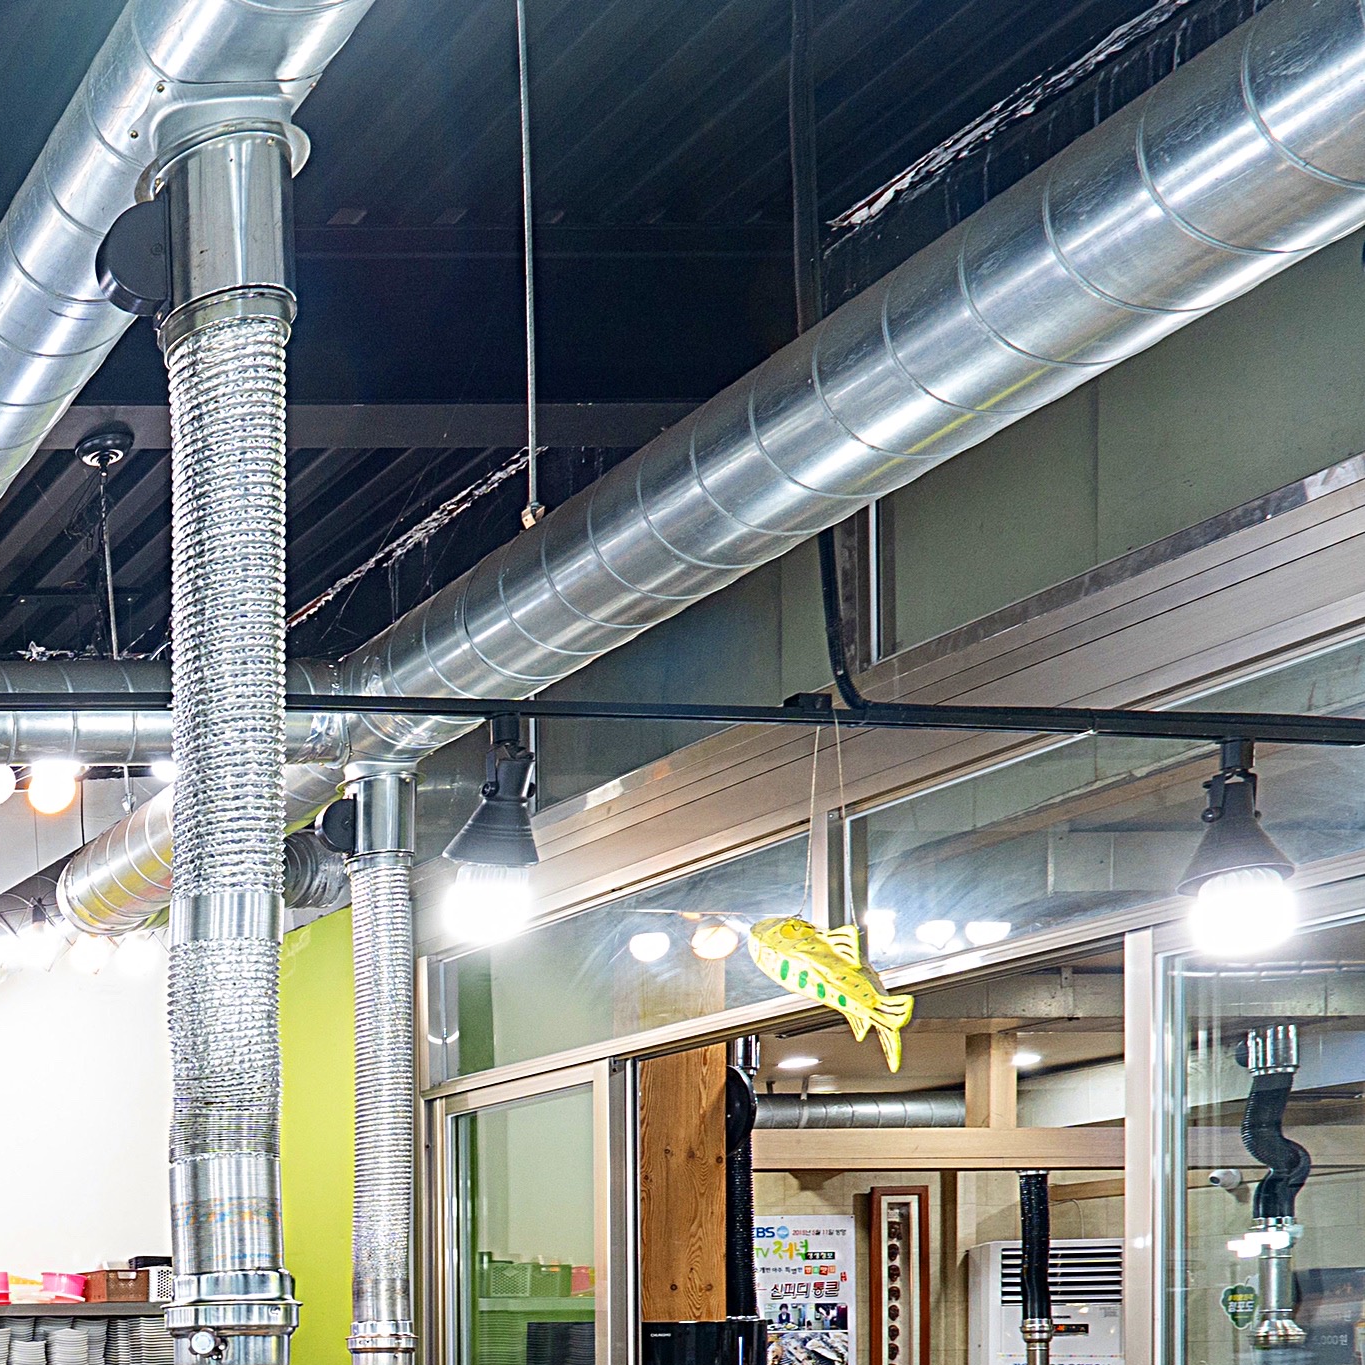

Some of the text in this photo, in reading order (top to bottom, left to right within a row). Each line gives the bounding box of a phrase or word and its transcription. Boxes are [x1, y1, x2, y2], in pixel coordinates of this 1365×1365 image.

[754, 1227, 775, 1238] BS
[772, 1239, 809, 1261] 저녁
[770, 1281, 840, 1300] 신피디 통큰
